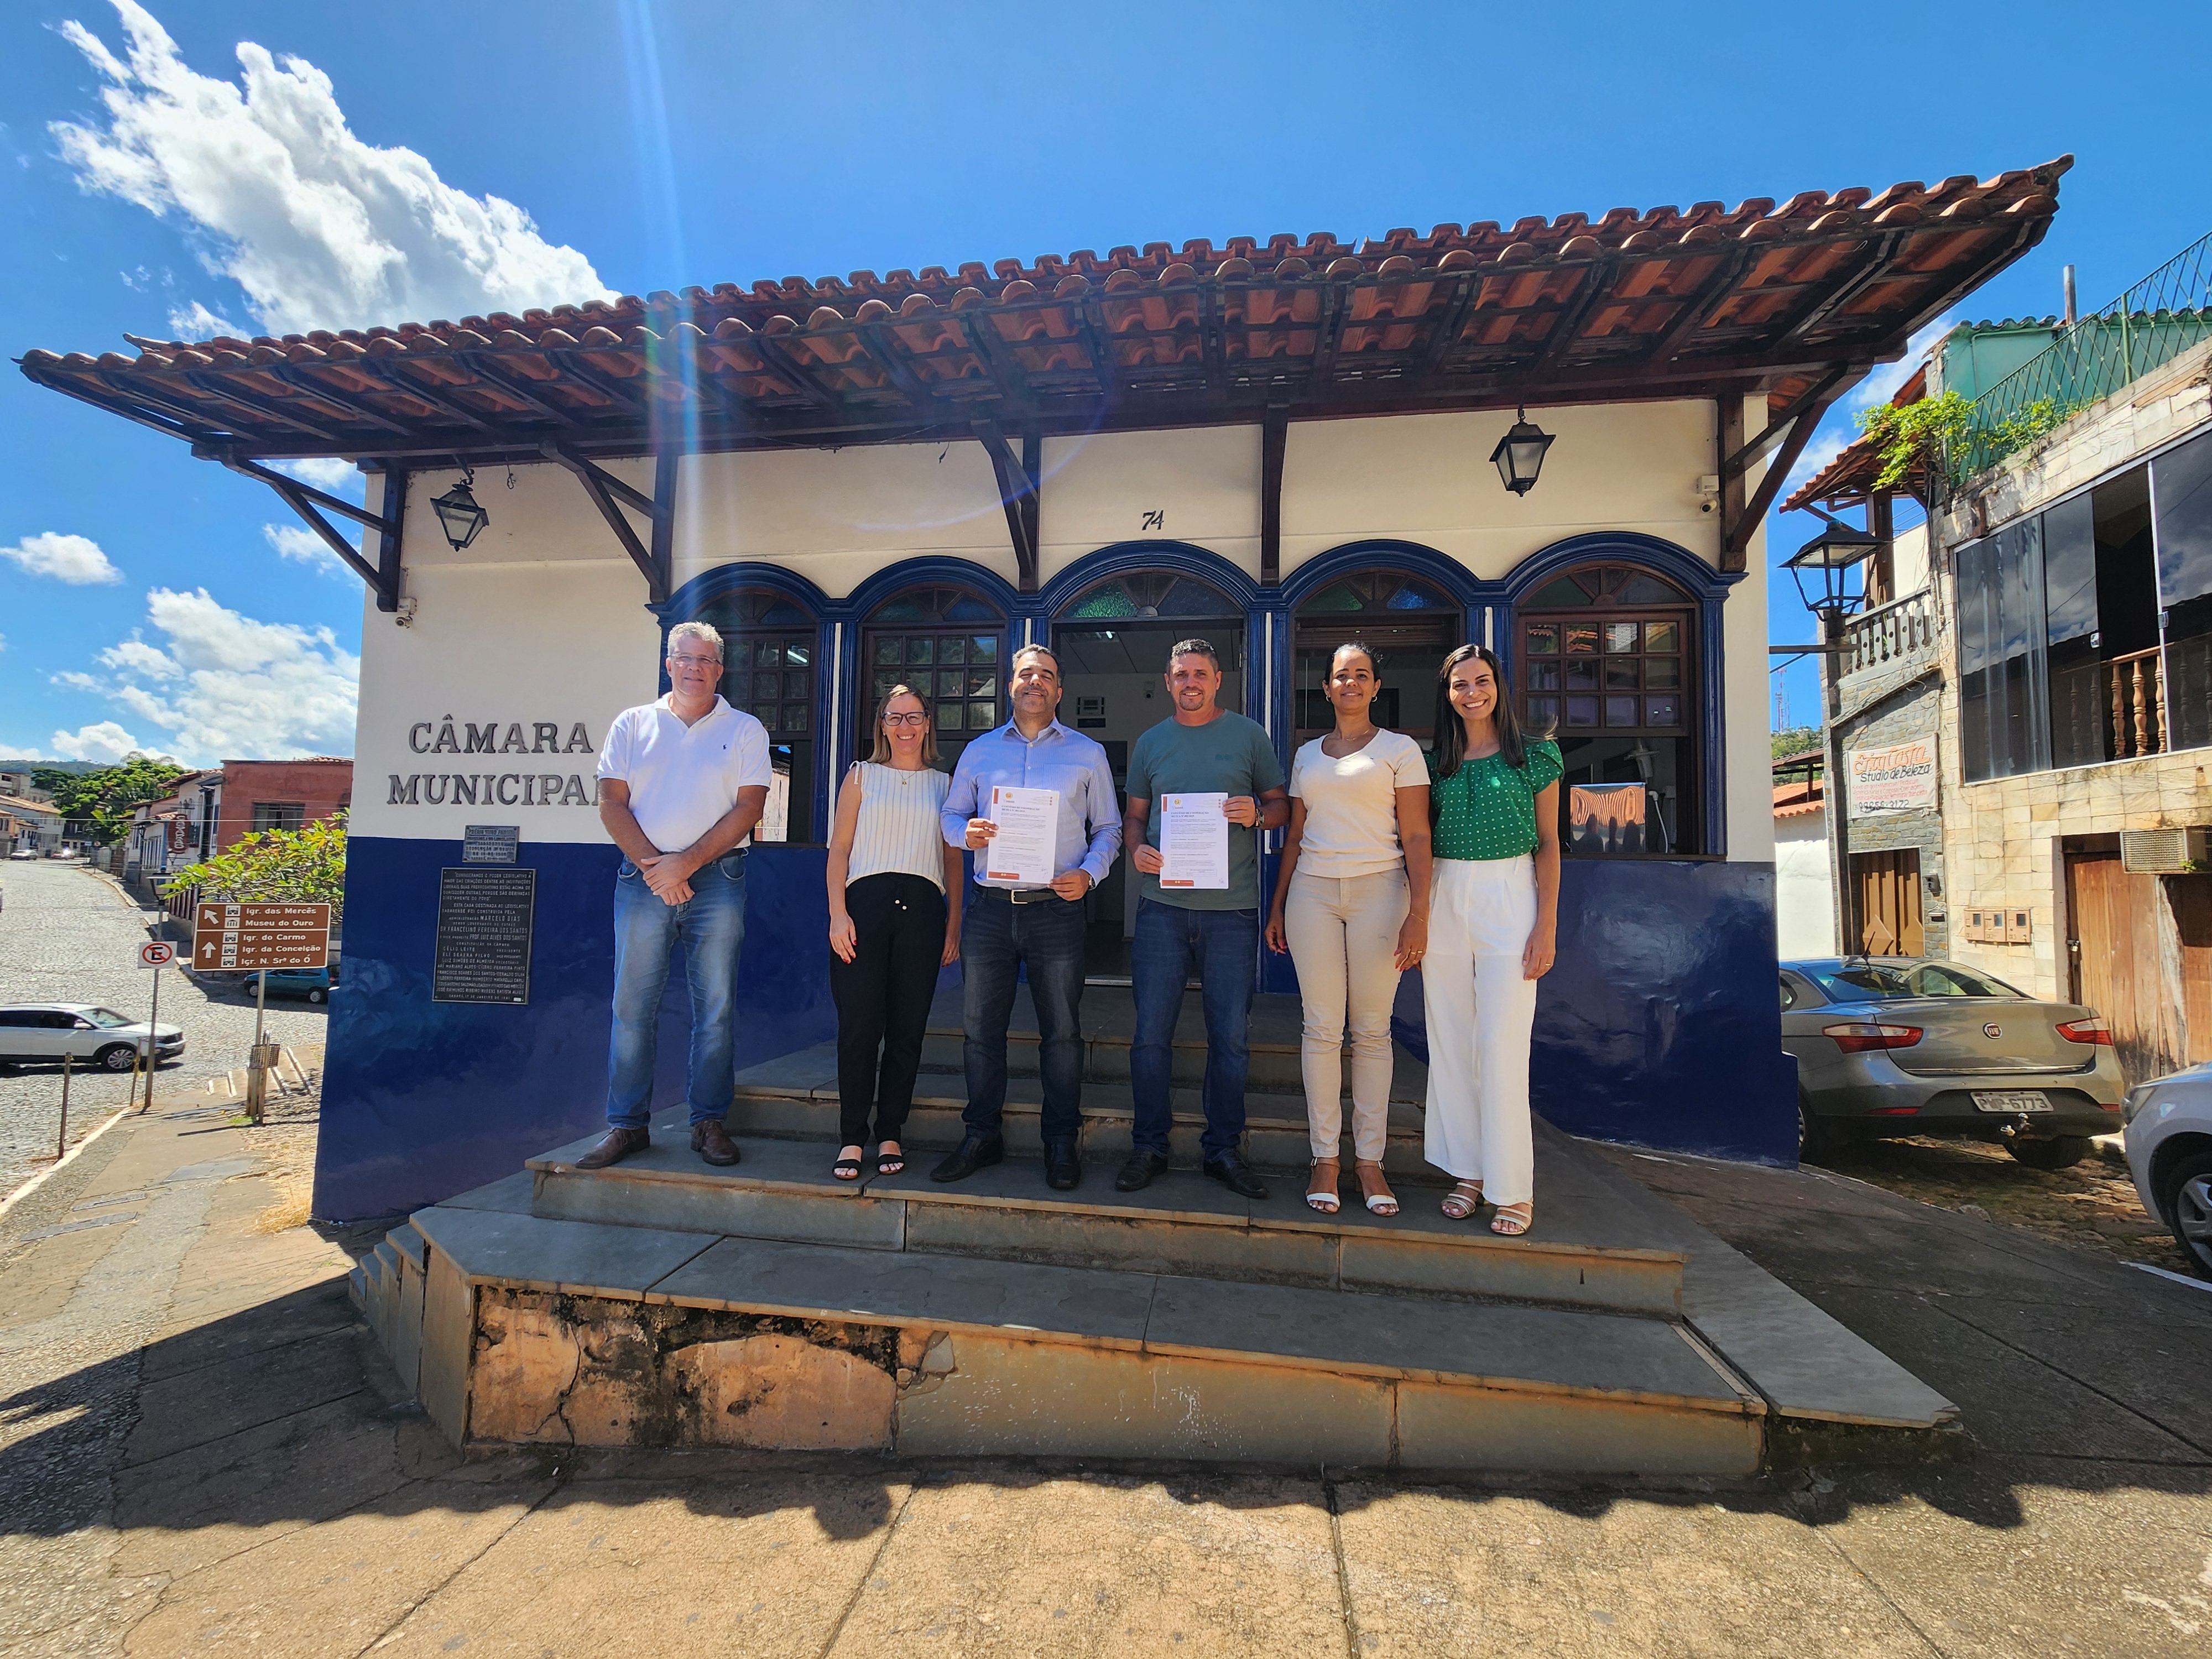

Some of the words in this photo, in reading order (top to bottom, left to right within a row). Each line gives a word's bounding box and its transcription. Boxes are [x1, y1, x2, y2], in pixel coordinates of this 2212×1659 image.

[1141, 510, 1165, 530] 74
[409, 714, 593, 753] CÂMARA
[1888, 743, 1931, 771] Costa
[1860, 770, 1889, 782] Studio
[1890, 768, 1898, 780] de
[1899, 764, 1931, 779] Beleza
[303, 954, 311, 963] Ó
